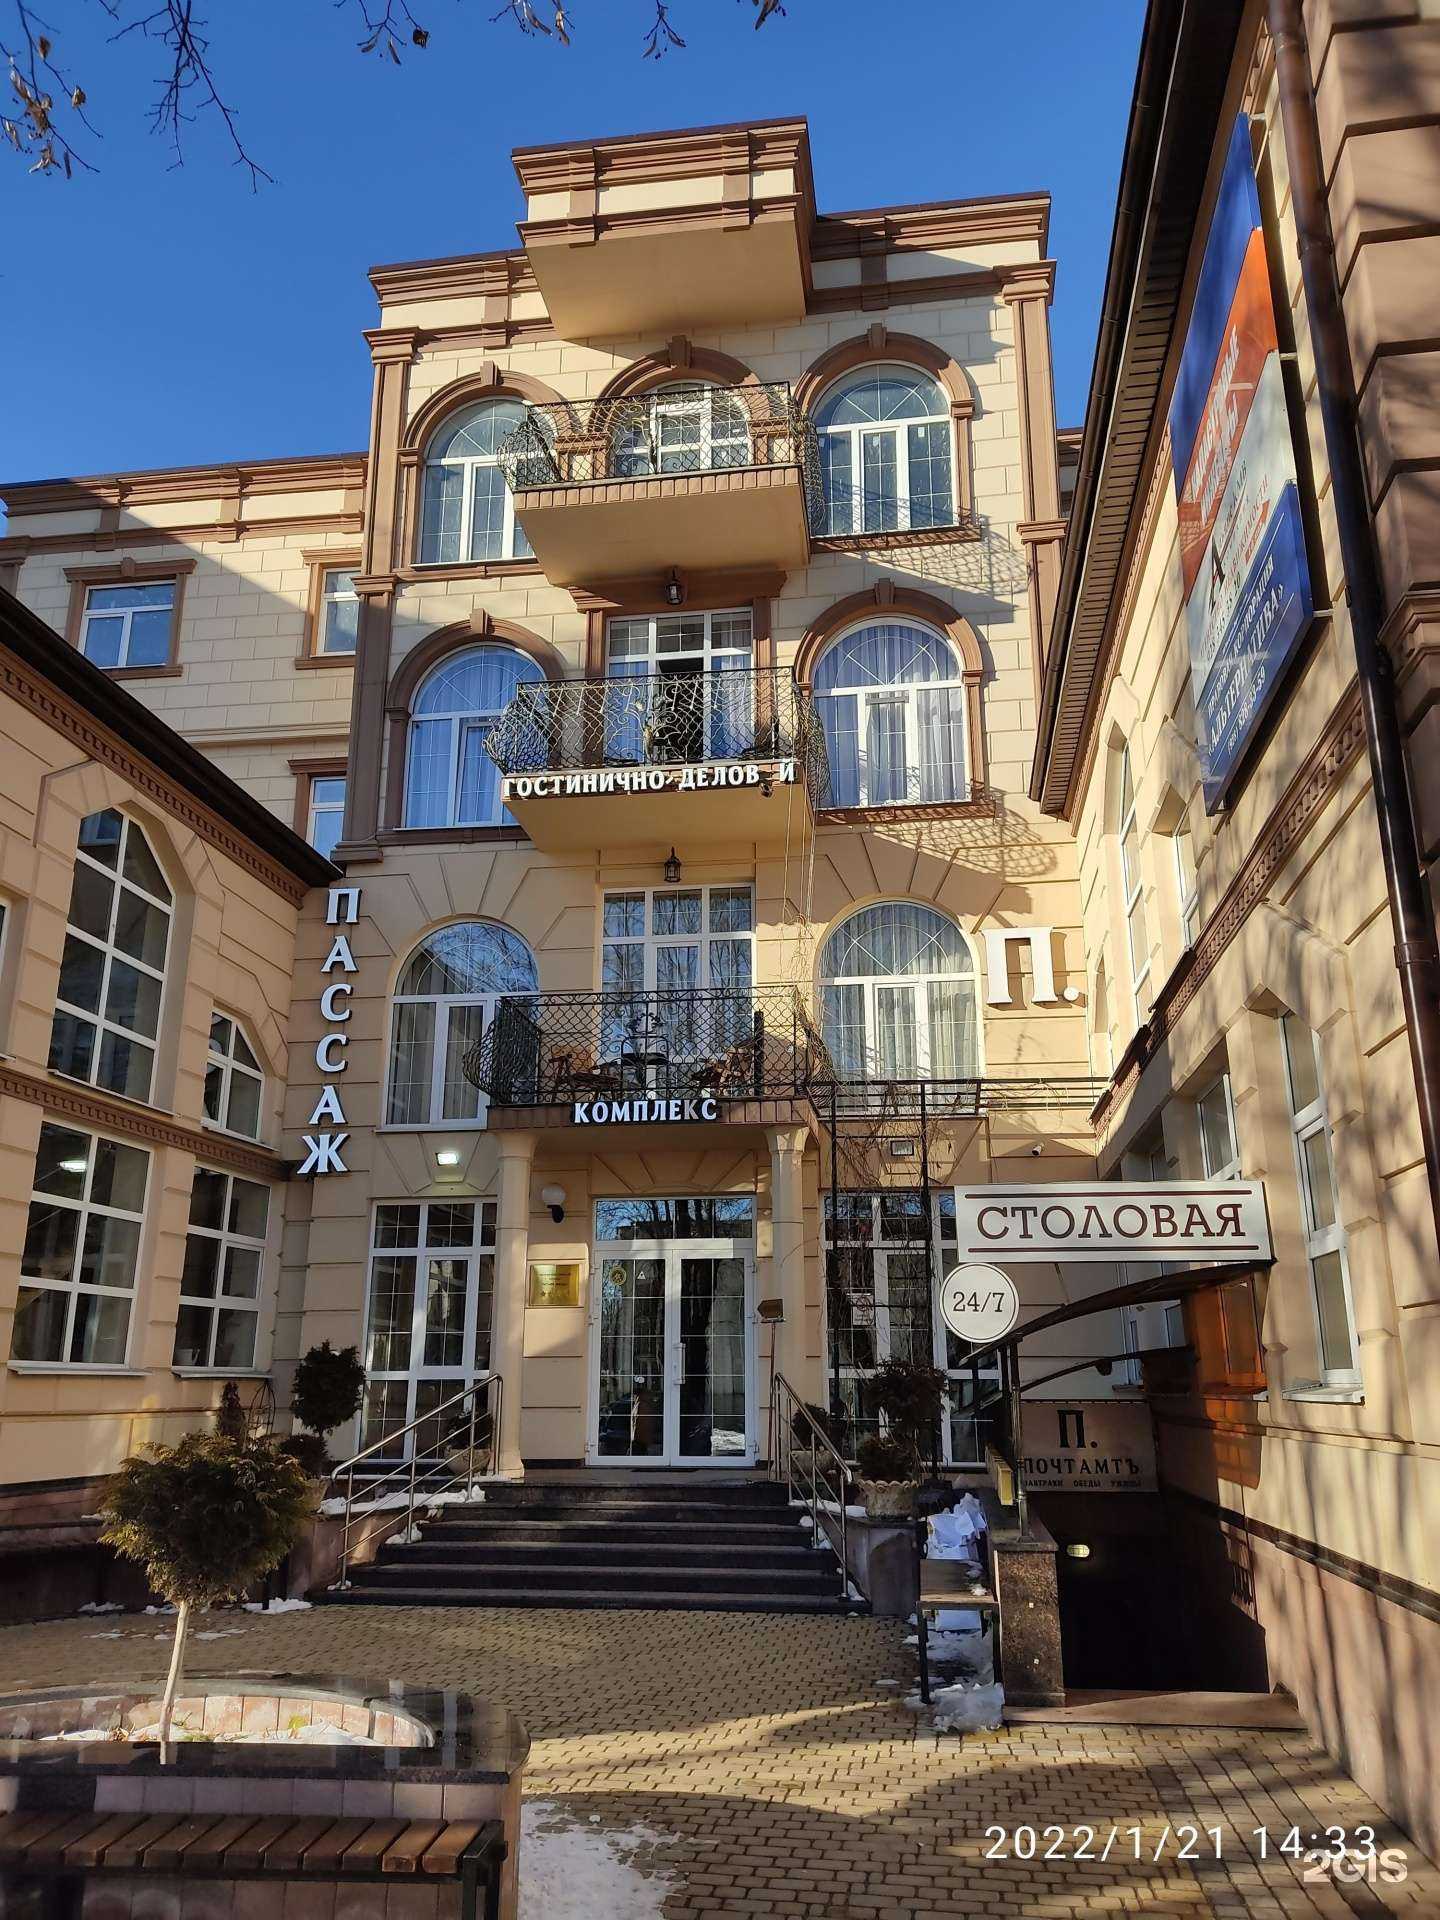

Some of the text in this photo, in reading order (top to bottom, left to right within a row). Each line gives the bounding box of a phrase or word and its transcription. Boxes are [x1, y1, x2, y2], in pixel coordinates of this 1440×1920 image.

[1233, 553, 1274, 657] КОРПОРАЦИЯ
[1208, 583, 1284, 757] «АЛЬТЕРНАТИВА»
[980, 926, 1080, 1004] П.
[297, 887, 361, 1174] ПАССАЖ
[574, 1098, 718, 1124] КОМПЛЕКС
[977, 1203, 1246, 1240] СТОЛОВАЯ
[952, 1291, 1005, 1313] 24/7
[1057, 1409, 1098, 1448] П.
[1024, 1458, 1140, 1475] ПОЧТАМТЪ
